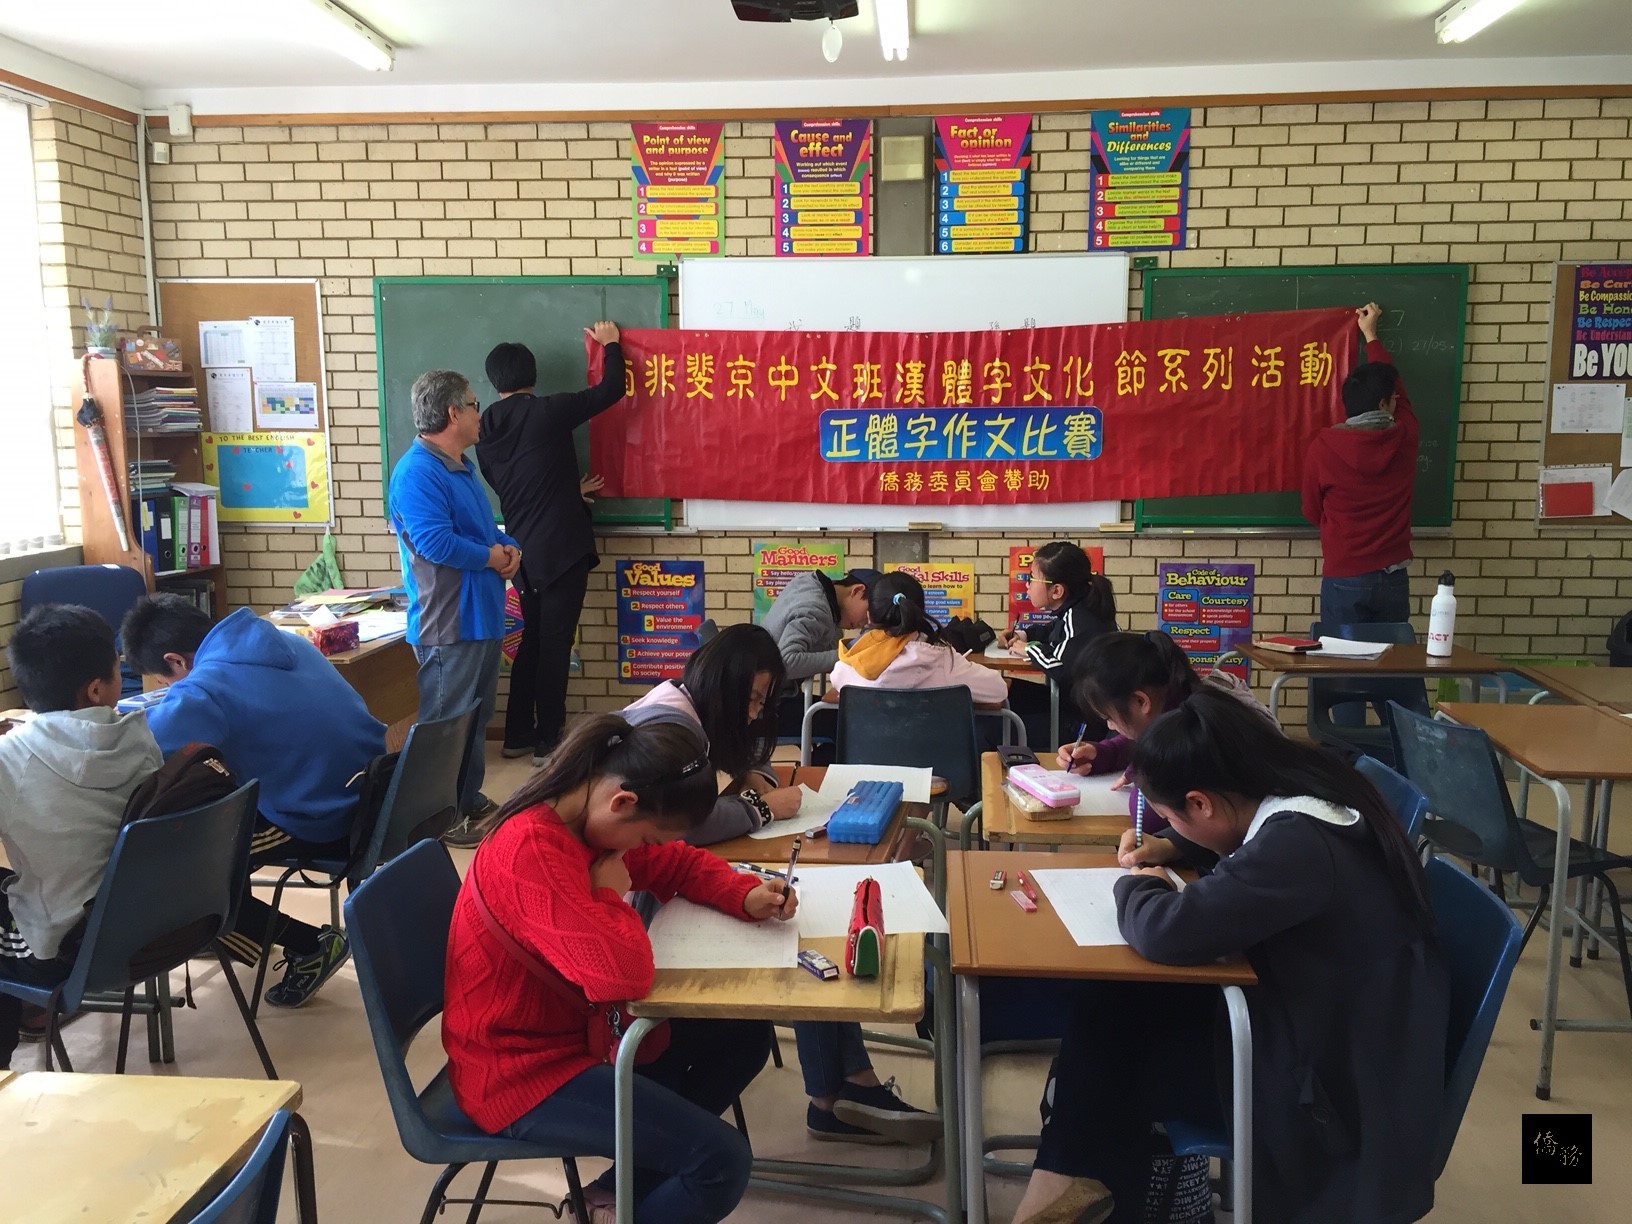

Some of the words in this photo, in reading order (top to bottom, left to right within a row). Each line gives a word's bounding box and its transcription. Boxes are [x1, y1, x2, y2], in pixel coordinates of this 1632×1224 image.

[1108, 120, 1171, 133] Similarities
[790, 129, 830, 143] Cause
[832, 131, 853, 142] and
[950, 125, 978, 139] Fact
[982, 127, 998, 138] or
[1130, 131, 1149, 141] and
[642, 135, 670, 145] Point
[673, 134, 684, 145] of
[687, 134, 711, 145] view
[960, 135, 1012, 151] opinion
[645, 145, 665, 155] and
[668, 147, 709, 156] purpose
[799, 141, 844, 158] effect
[1106, 141, 1172, 154] Differences
[943, 172, 948, 181] 1
[1098, 176, 1103, 185] 1
[639, 187, 644, 196] 1
[782, 184, 788, 194] 1
[942, 186, 949, 195] 2
[1097, 191, 1104, 200] 2
[638, 204, 646, 213] 2
[782, 199, 789, 208] 2
[942, 200, 949, 209] 3
[1096, 206, 1104, 216] 3
[782, 213, 789, 223] 3
[941, 214, 949, 223] 4
[639, 224, 647, 233] 3
[1096, 221, 1103, 230] 4
[782, 228, 790, 237] 4
[941, 228, 949, 237] 5
[1095, 236, 1103, 245] 5
[639, 242, 647, 252] 4
[782, 242, 790, 252] 5
[941, 242, 949, 251] 6
[1580, 280, 1600, 289] Be
[1579, 290, 1590, 301] Be
[1578, 303, 1598, 314] Be
[1602, 303, 1632, 314] Hon
[1576, 316, 1592, 328] Be
[1594, 316, 1632, 330] Respec
[1576, 330, 1587, 340] Be
[1590, 330, 1632, 340] Understan
[1572, 343, 1599, 377] Be
[825, 411, 1098, 460] 正體字作文比賽
[879, 468, 1051, 494] 僑務委員會贊助
[777, 546, 806, 555] Good
[761, 550, 837, 566] Manners
[632, 562, 662, 571] Good
[897, 565, 921, 573] Good
[624, 569, 696, 588] Values
[931, 571, 970, 583] Skills
[1166, 572, 1248, 586] Behaviour
[632, 589, 655, 597] Respect
[656, 589, 680, 597] yourself
[1168, 591, 1192, 600] Care
[1201, 596, 1249, 606] Courtesy
[646, 619, 653, 627] 3
[1170, 626, 1210, 636] Respect
[646, 637, 679, 645] knowledge
[622, 665, 630, 674] 6
